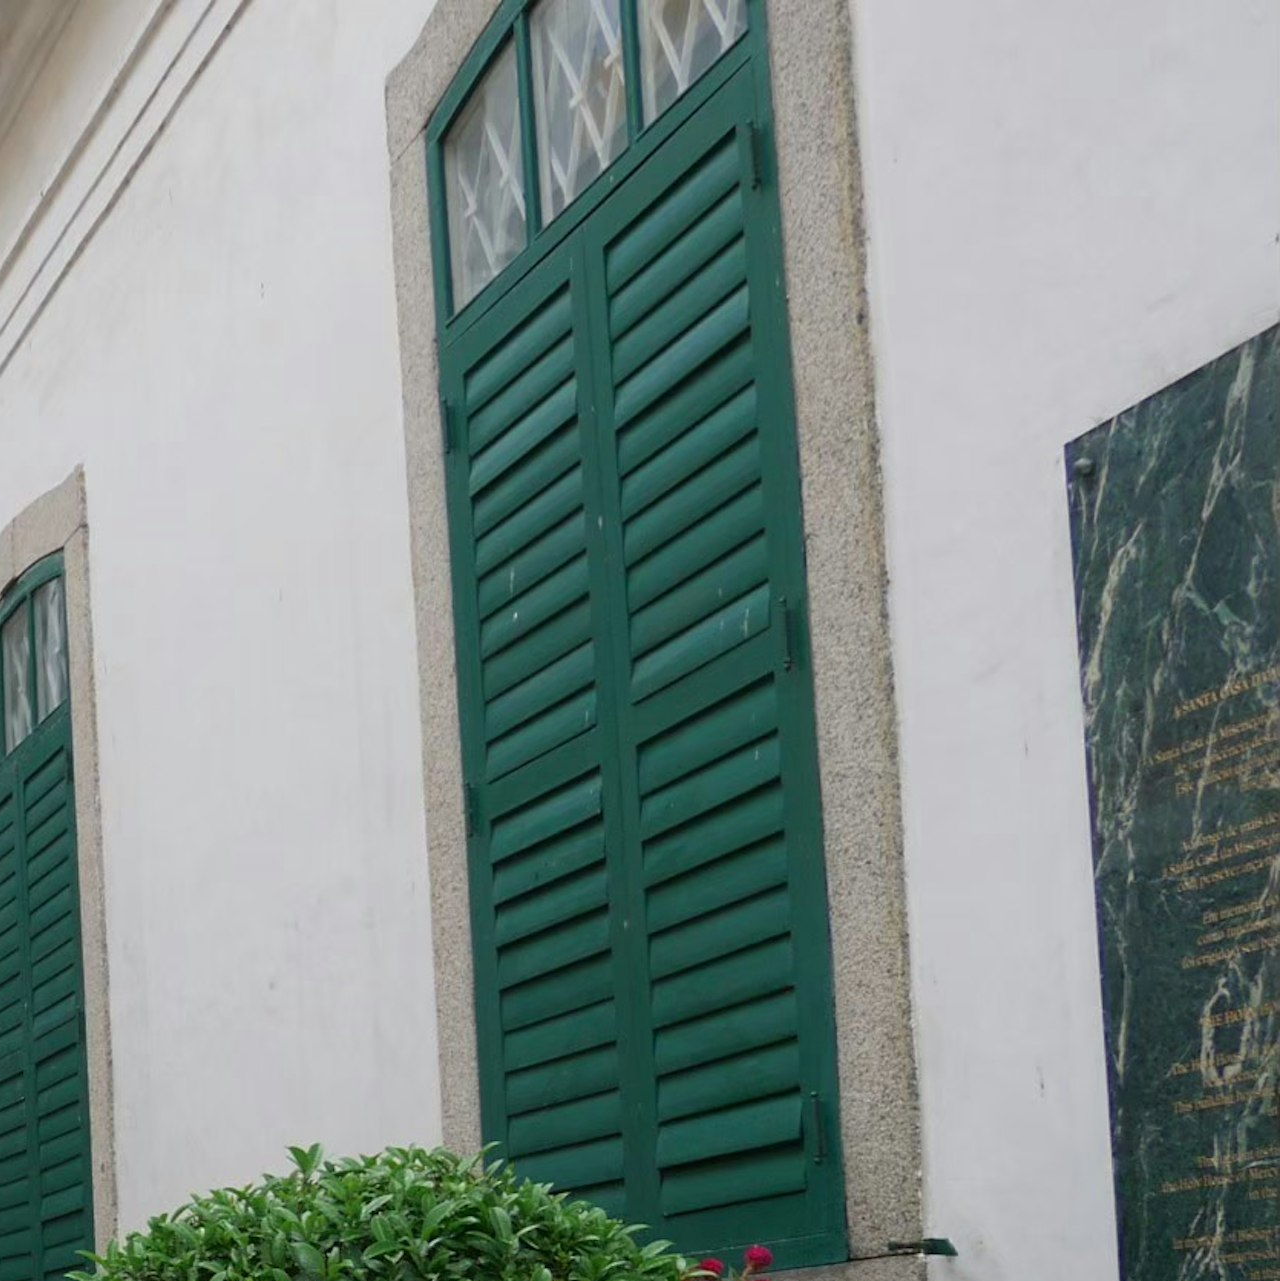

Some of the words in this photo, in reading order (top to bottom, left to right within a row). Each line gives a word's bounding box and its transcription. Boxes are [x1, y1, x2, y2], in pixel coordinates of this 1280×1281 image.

[1182, 692, 1218, 712] SANTA
[1219, 679, 1249, 699] CASA
[1155, 747, 1181, 764] Santa
